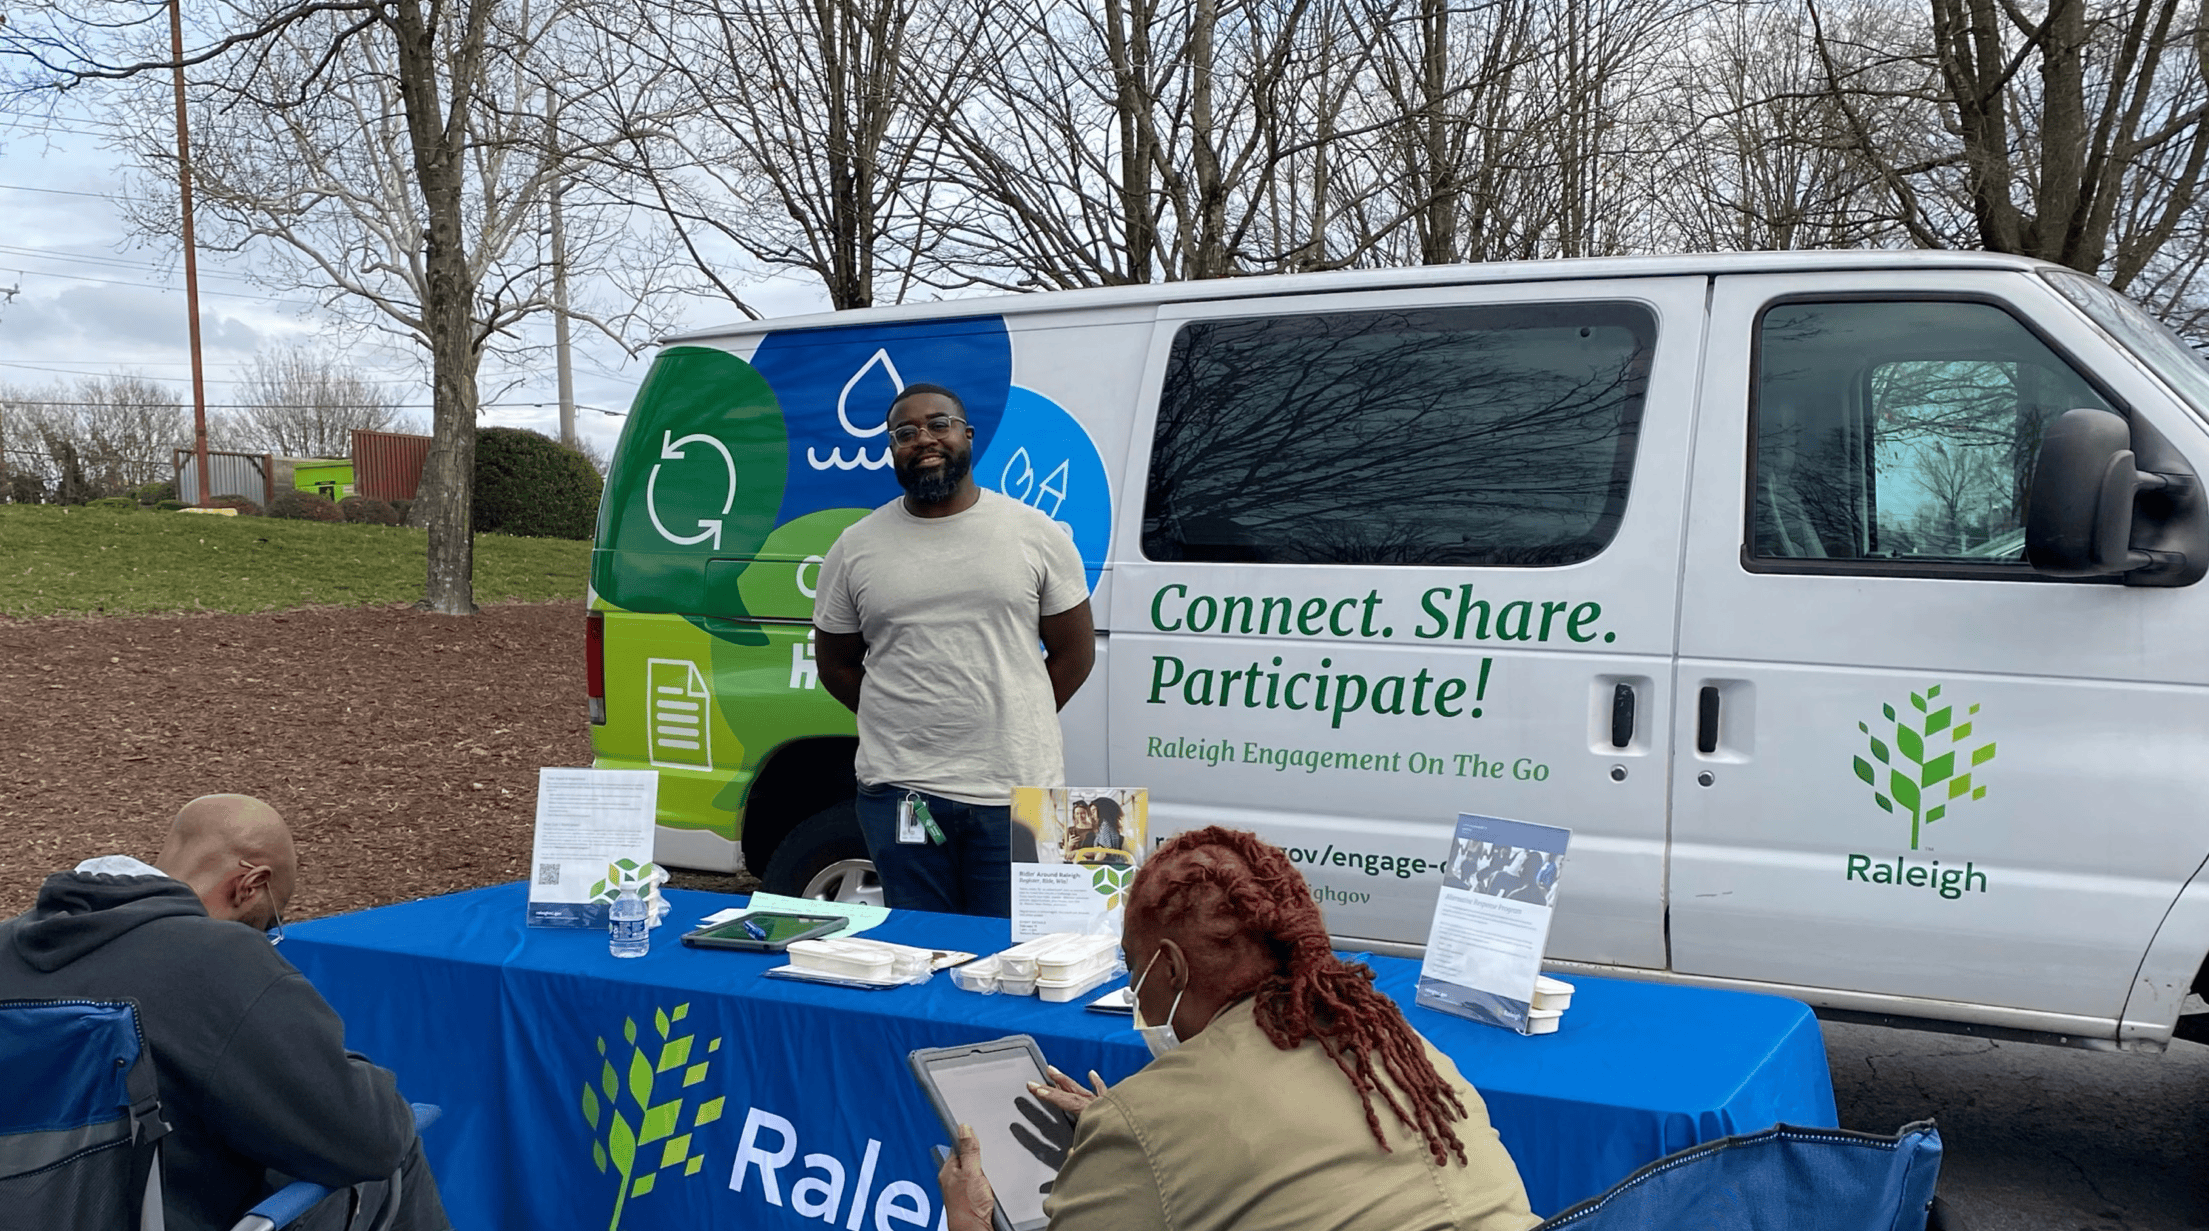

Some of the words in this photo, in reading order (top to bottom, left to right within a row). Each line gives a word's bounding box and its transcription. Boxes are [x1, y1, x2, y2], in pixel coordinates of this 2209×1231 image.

[1151, 584, 1394, 638] Connect.
[1414, 584, 1617, 643] Share.
[1146, 656, 1493, 729] Participate!
[1147, 737, 1235, 767] Raleigh
[1242, 743, 1401, 773] Engagement
[1408, 752, 1444, 775] On
[1454, 754, 1504, 779] The
[1512, 758, 1550, 782] Go
[1847, 854, 1987, 900] Raleigh
